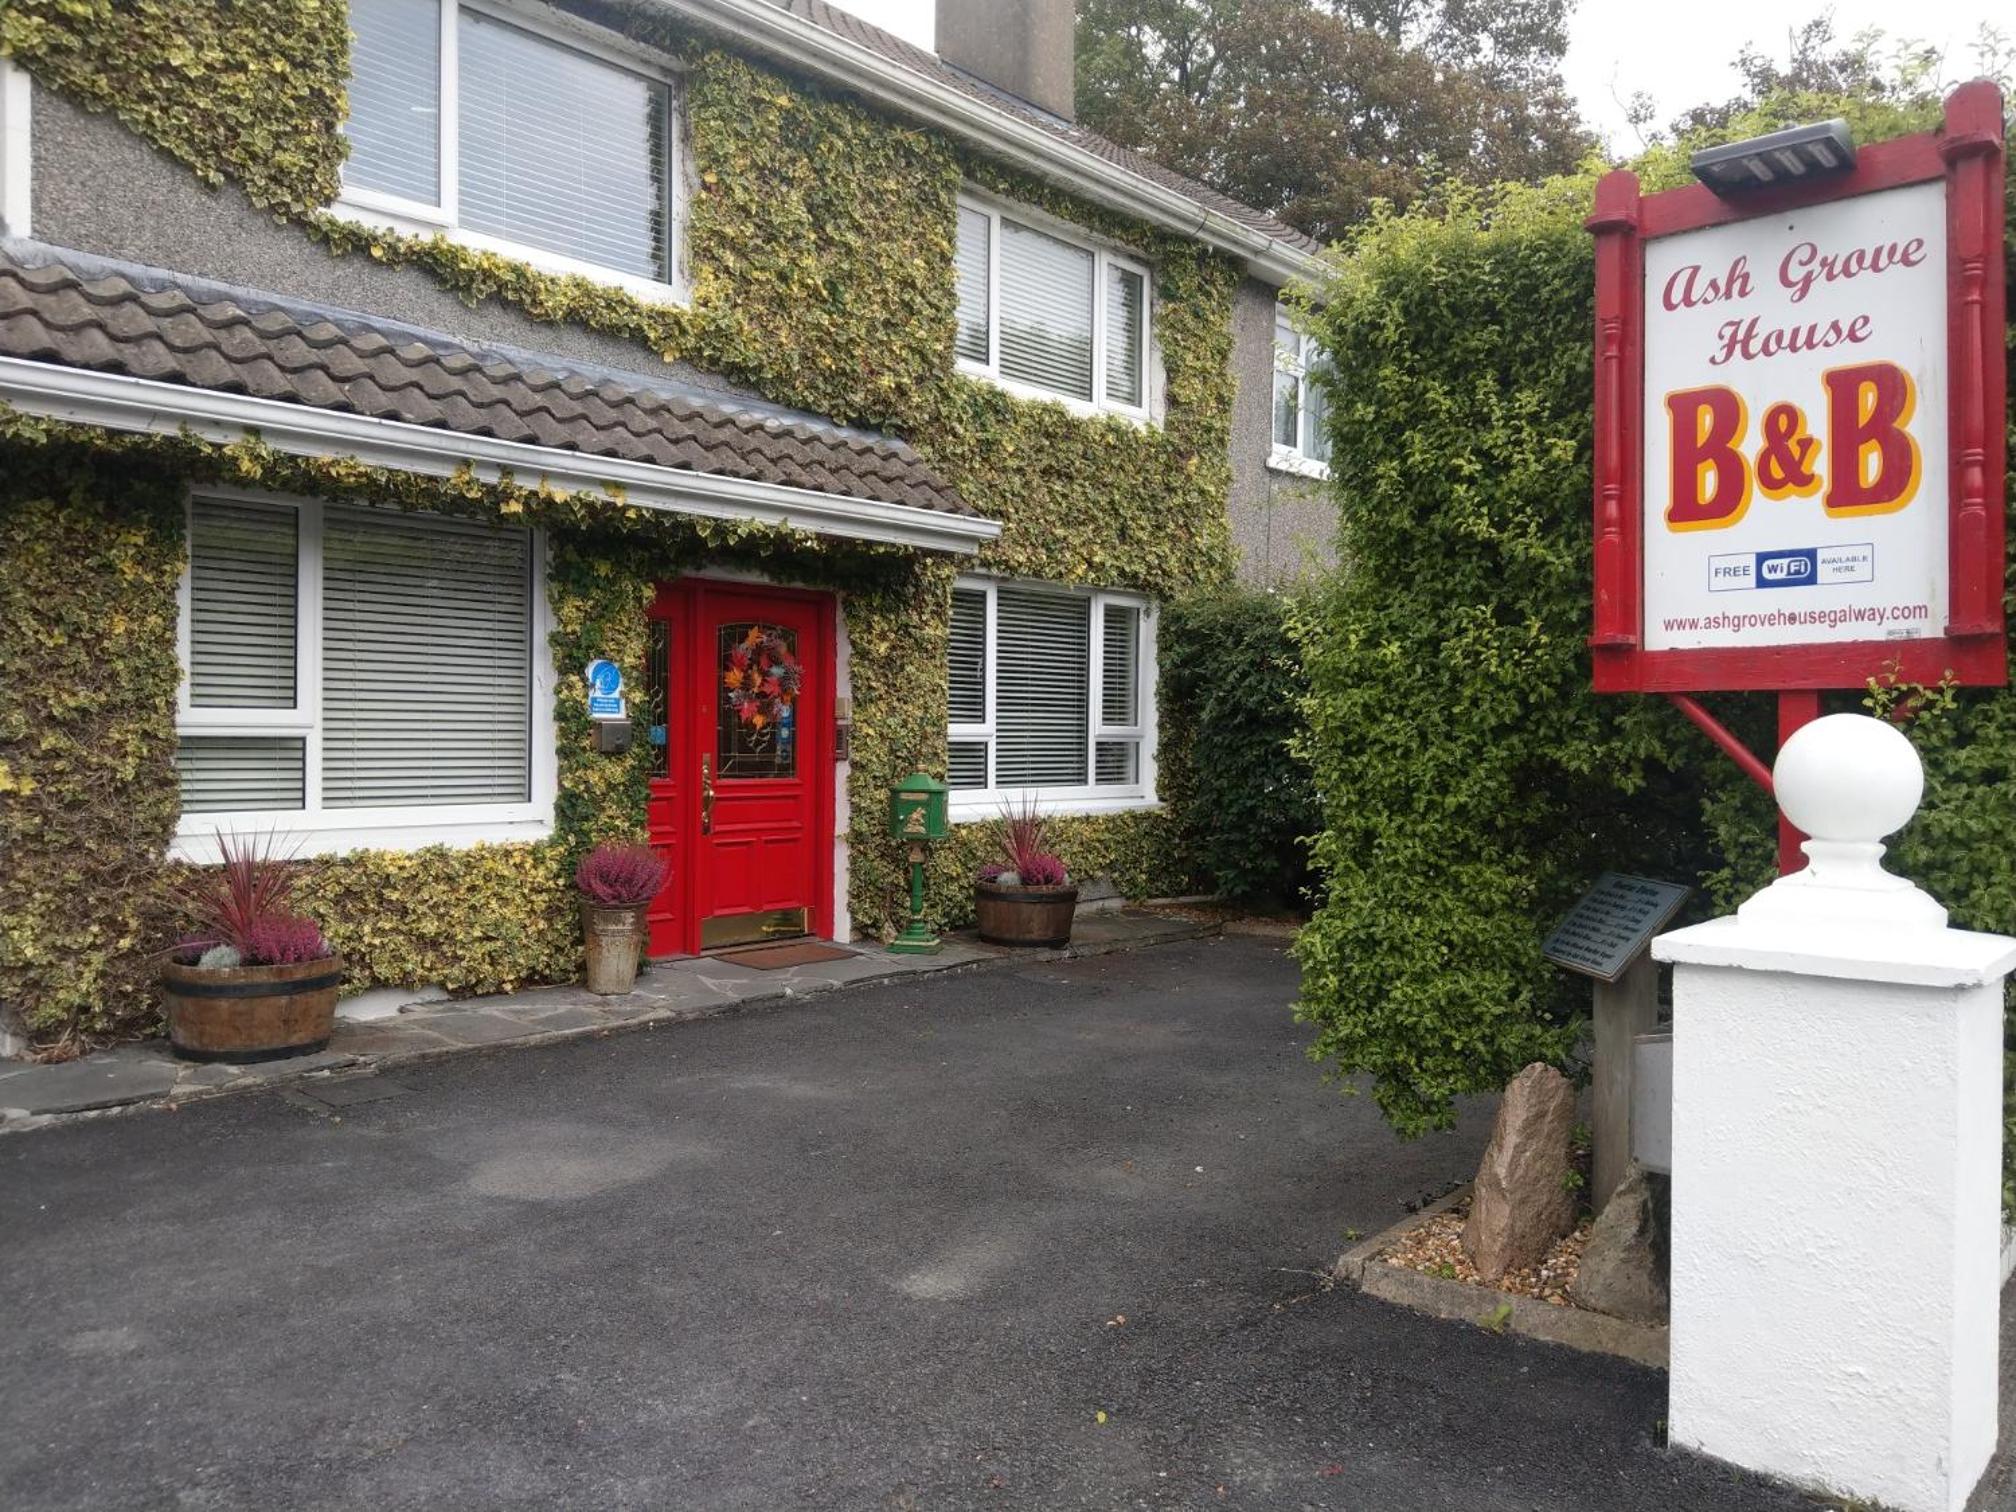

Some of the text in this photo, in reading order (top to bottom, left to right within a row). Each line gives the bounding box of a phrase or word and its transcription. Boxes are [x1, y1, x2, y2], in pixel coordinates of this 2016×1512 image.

[1662, 237, 1927, 312] Ash Grove
[1709, 314, 1873, 366] House
[1664, 360, 1922, 533] B&B
[1714, 565, 1751, 578] FREE
[1821, 555, 1869, 565] AVAILABLE
[1832, 565, 1856, 574] HERE
[1663, 604, 1928, 632] www.ashgrovehousegalway.com
